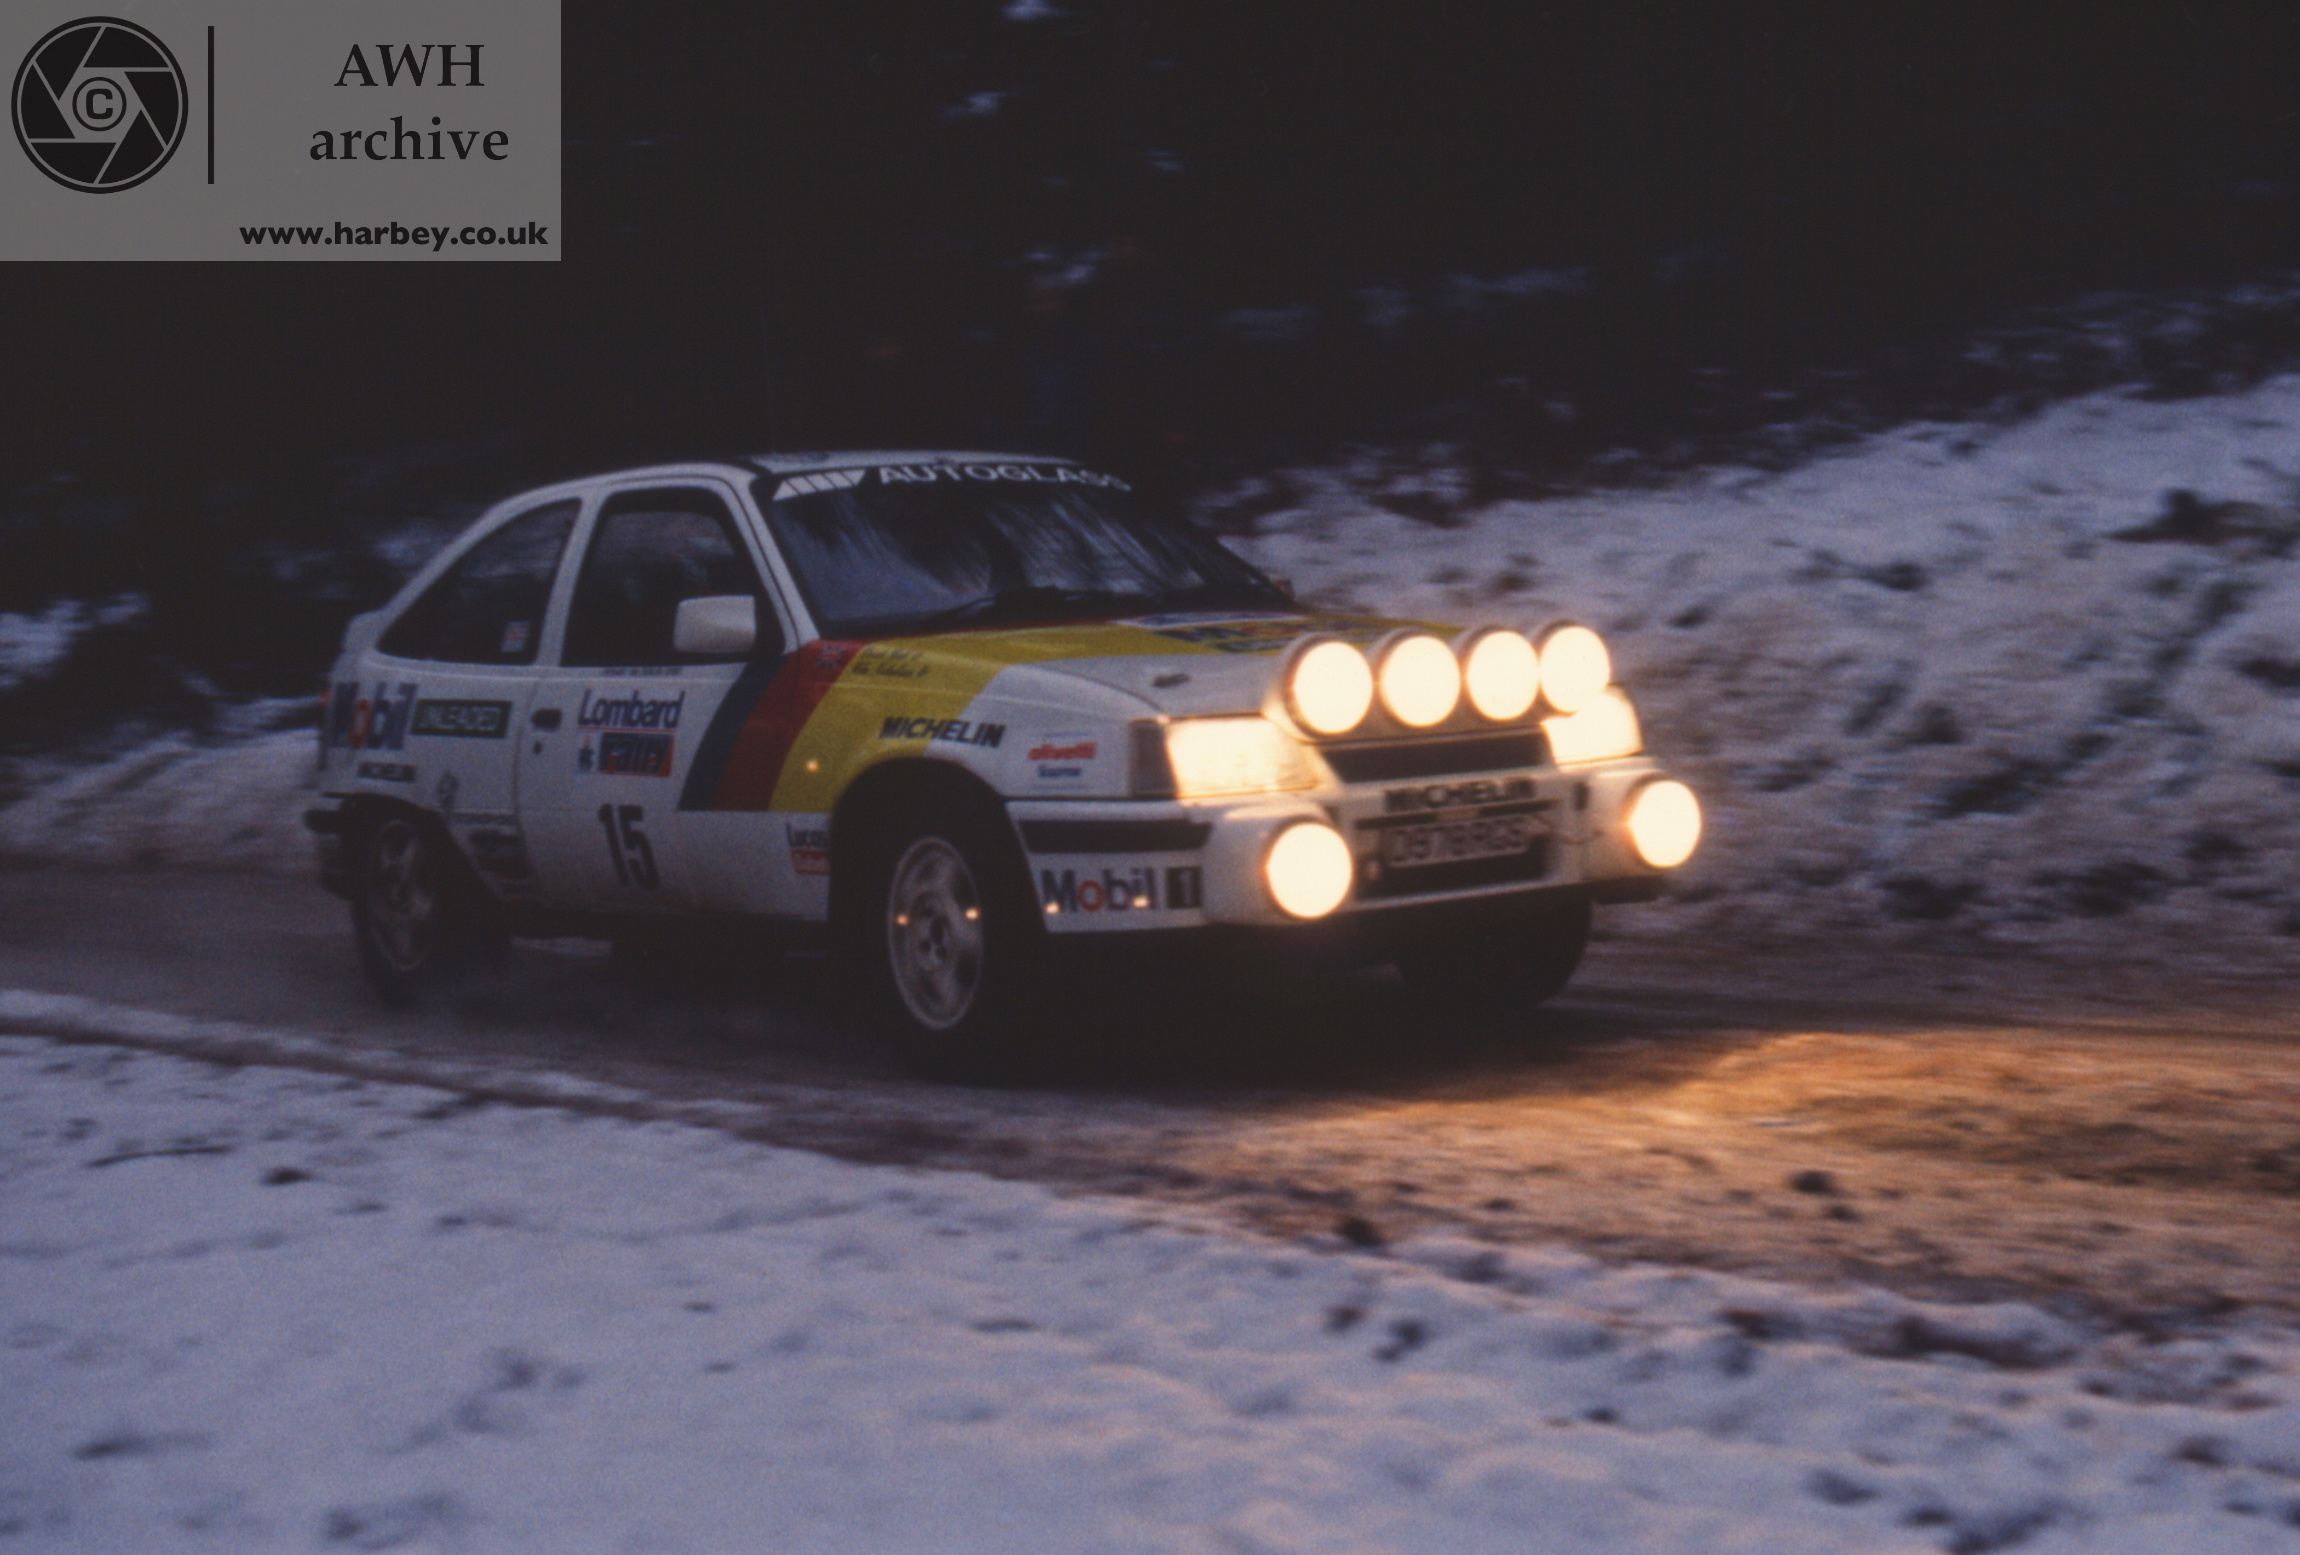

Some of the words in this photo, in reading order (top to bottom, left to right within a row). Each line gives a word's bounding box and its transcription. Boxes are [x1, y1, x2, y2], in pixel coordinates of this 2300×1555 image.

[878, 464, 1133, 492] AUTOGLASS
[577, 688, 687, 729] Lombard
[878, 716, 1006, 749] MICHELIN
[599, 803, 660, 889] 15
[1040, 866, 1155, 912] Mobil
